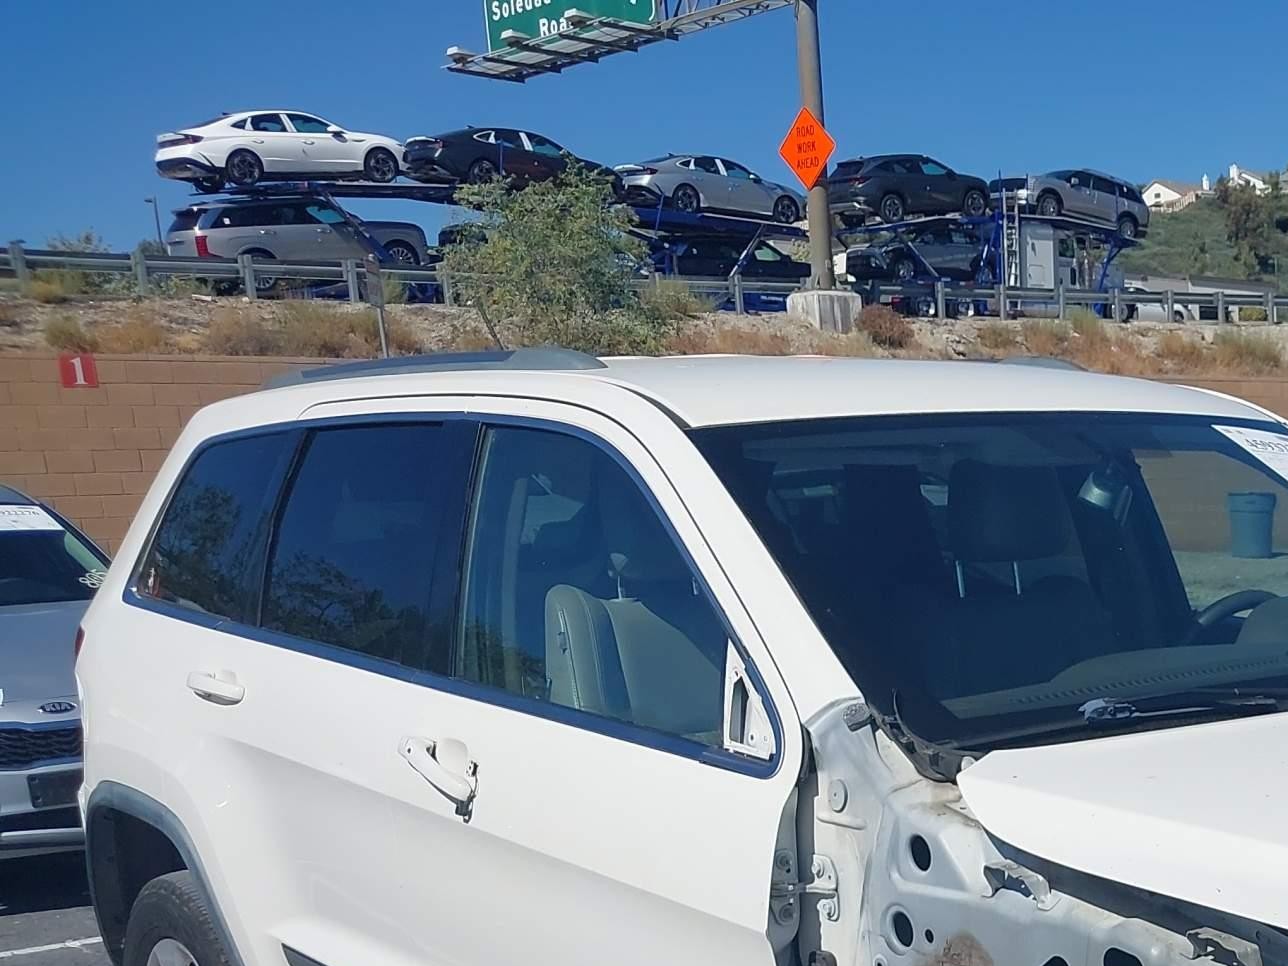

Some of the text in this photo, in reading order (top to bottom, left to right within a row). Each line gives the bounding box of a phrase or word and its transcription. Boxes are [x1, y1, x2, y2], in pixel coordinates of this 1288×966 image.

[492, 0, 551, 21] Soleda
[796, 125, 815, 137] ROAD
[797, 141, 816, 153] WORK
[797, 156, 820, 169] AHEAD
[70, 357, 88, 385] 1
[43, 702, 72, 712] KIA
